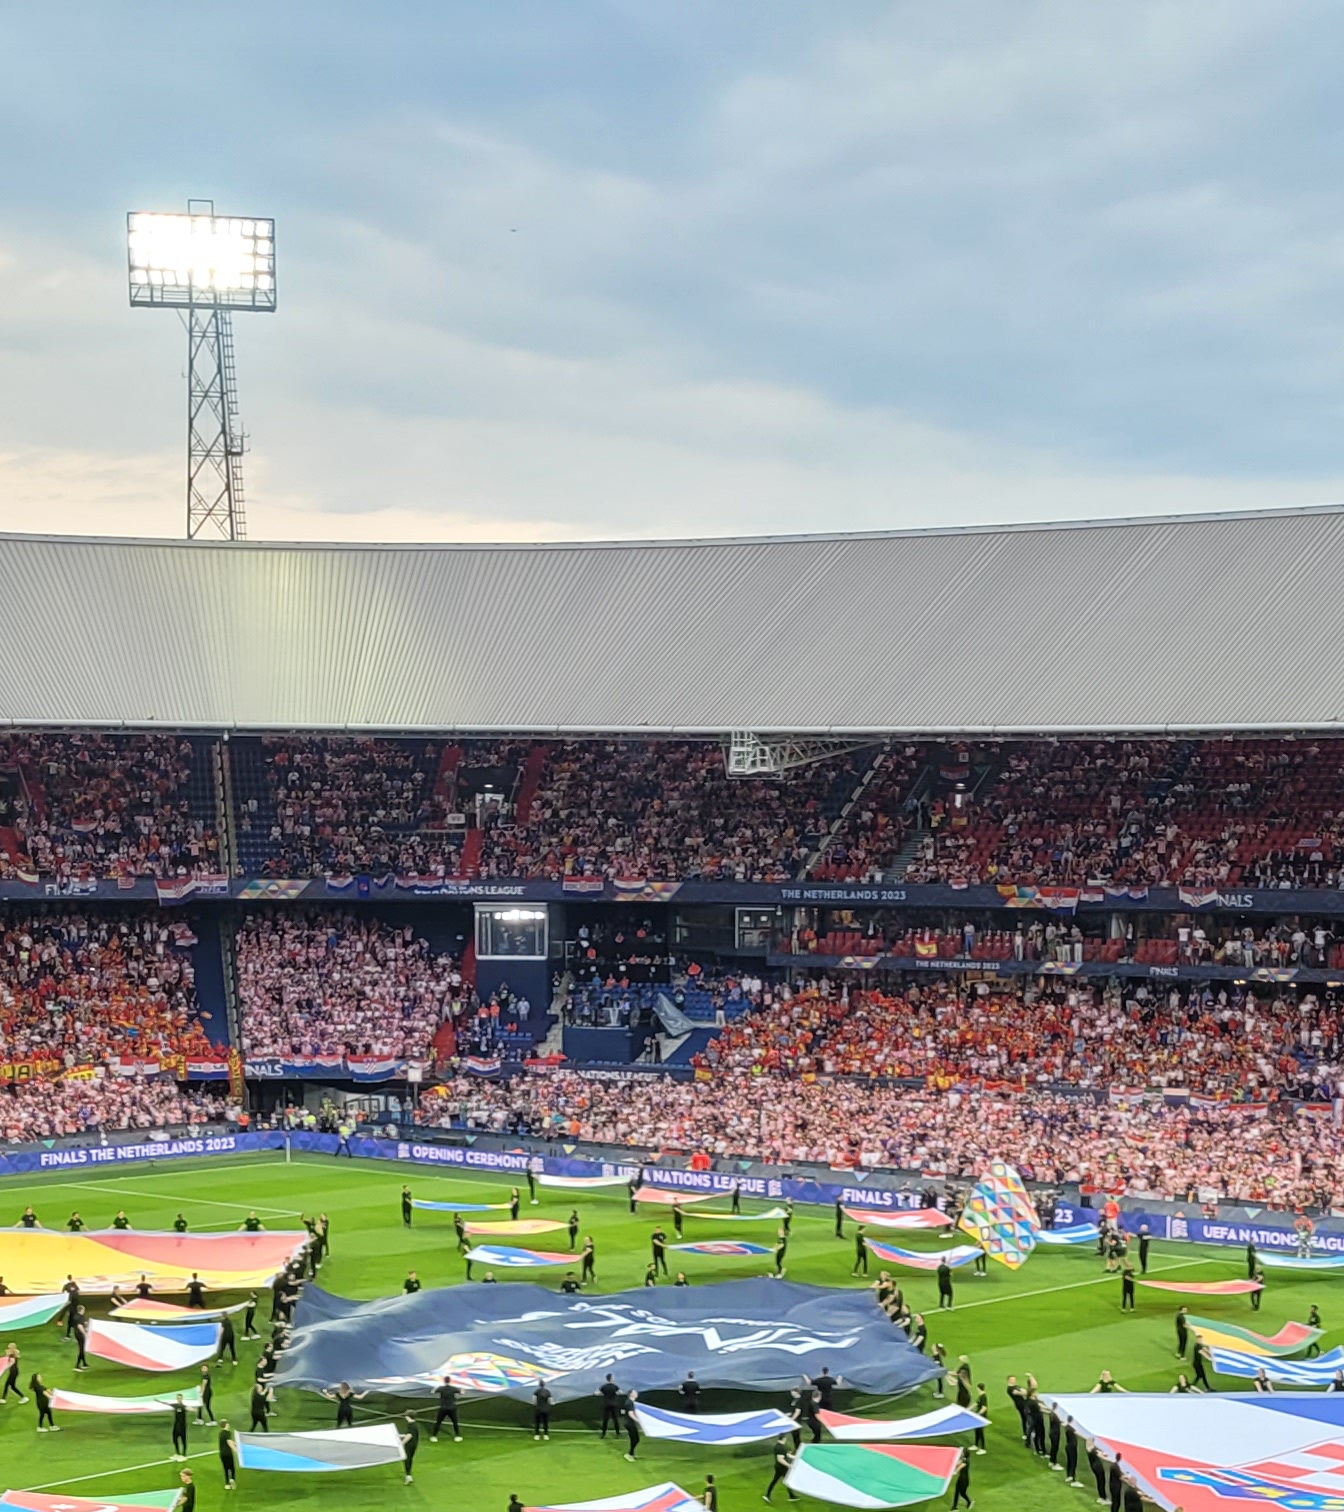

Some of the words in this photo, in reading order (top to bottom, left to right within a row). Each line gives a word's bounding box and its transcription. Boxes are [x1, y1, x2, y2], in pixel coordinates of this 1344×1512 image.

[780, 889, 801, 899] THE
[802, 889, 879, 900] NETHERLANDS
[880, 890, 906, 901] 2023
[1217, 894, 1254, 908] NALS
[244, 1064, 284, 1077] NALS
[40, 1149, 88, 1166] FINALS
[89, 1147, 115, 1162] THE
[116, 1140, 204, 1160] NETHERLANDS
[205, 1137, 236, 1150] 2023
[412, 1145, 464, 1162] OPENING
[465, 1150, 529, 1170] CEREMONY
[655, 1169, 712, 1188] NATIONS
[714, 1175, 765, 1192] LEAGUE
[843, 1190, 893, 1206] FINALS
[896, 1193, 922, 1209] TE
[1202, 1225, 1238, 1240] UEFA
[1239, 1230, 1298, 1248] NATIONS
